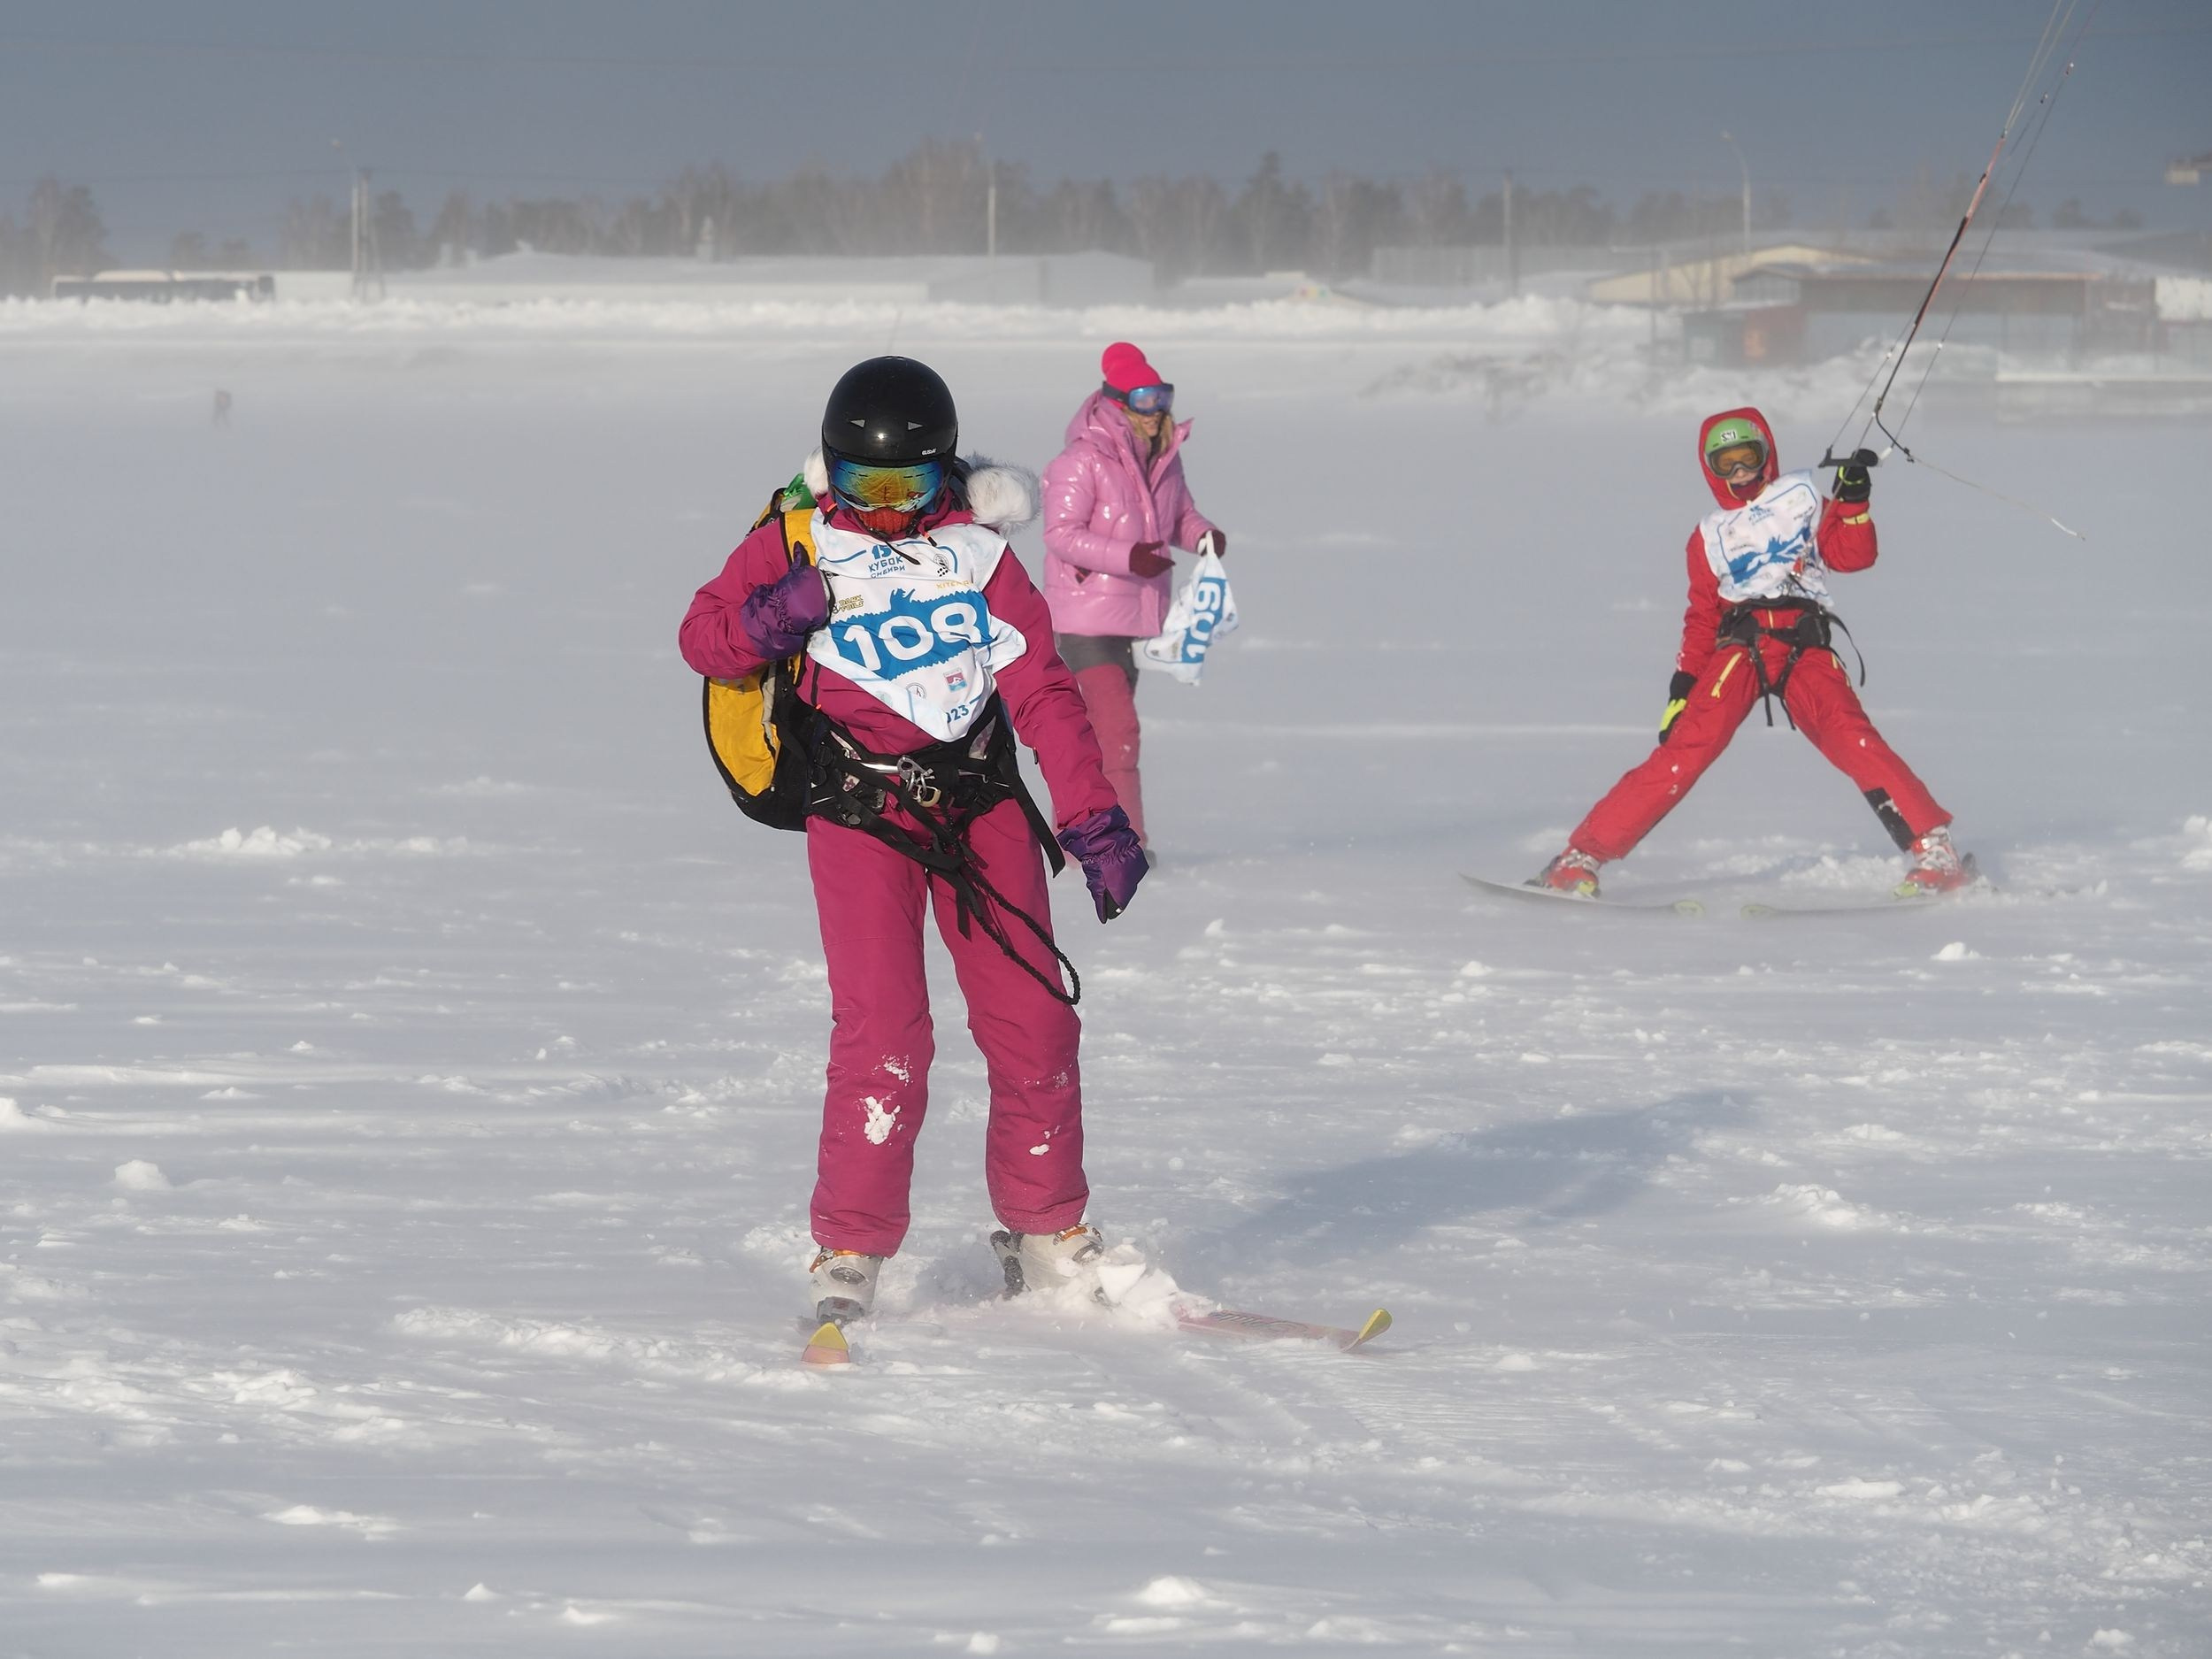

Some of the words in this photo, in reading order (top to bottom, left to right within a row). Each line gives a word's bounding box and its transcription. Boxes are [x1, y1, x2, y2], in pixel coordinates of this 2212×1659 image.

[868, 556, 903, 572] КУБОК
[870, 565, 905, 579] СИБИРИ
[844, 602, 981, 671] 108
[1187, 581, 1222, 658] 109
